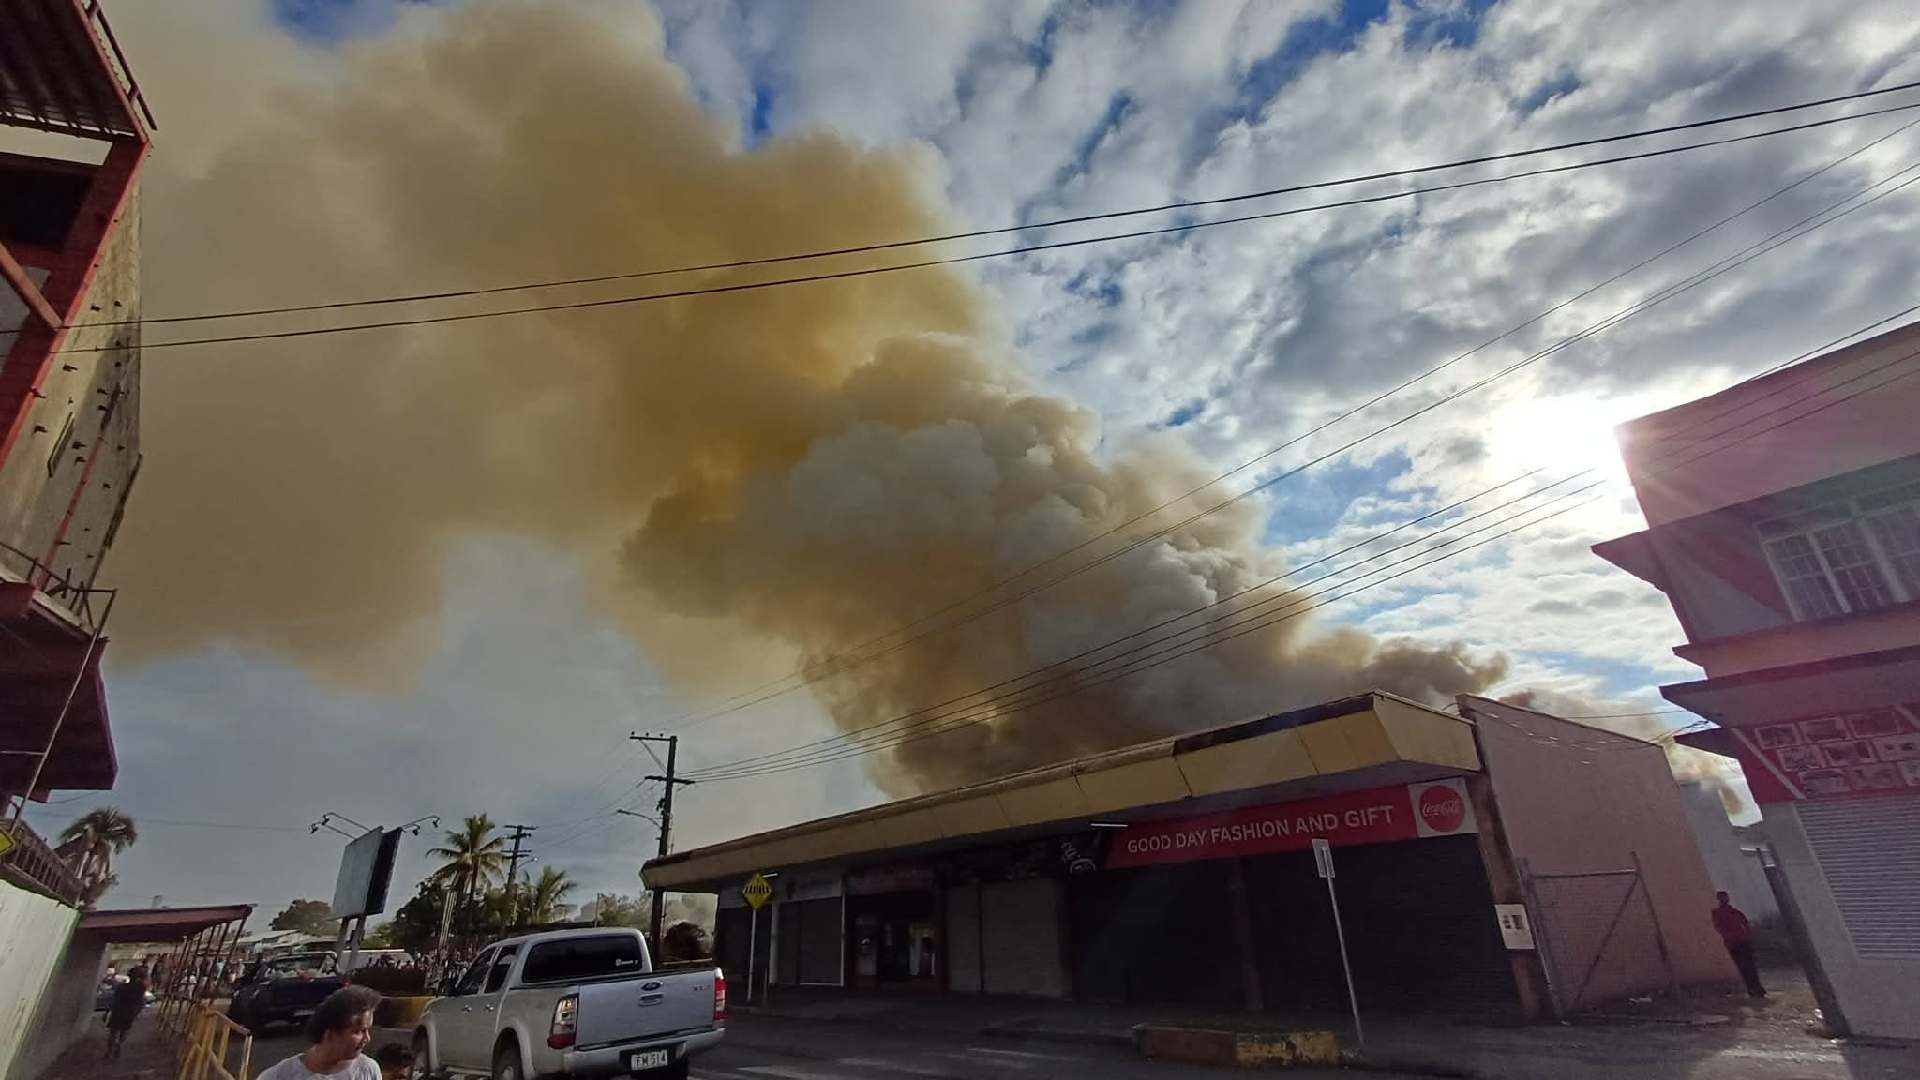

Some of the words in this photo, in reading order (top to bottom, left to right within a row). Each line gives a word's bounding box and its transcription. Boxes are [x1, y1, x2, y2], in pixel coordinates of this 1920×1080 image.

[1127, 835, 1171, 853] GOOD
[1175, 830, 1207, 848] DAY
[1210, 818, 1290, 845] FASHION
[1296, 813, 1338, 833] AND
[1344, 805, 1393, 827] GIFT
